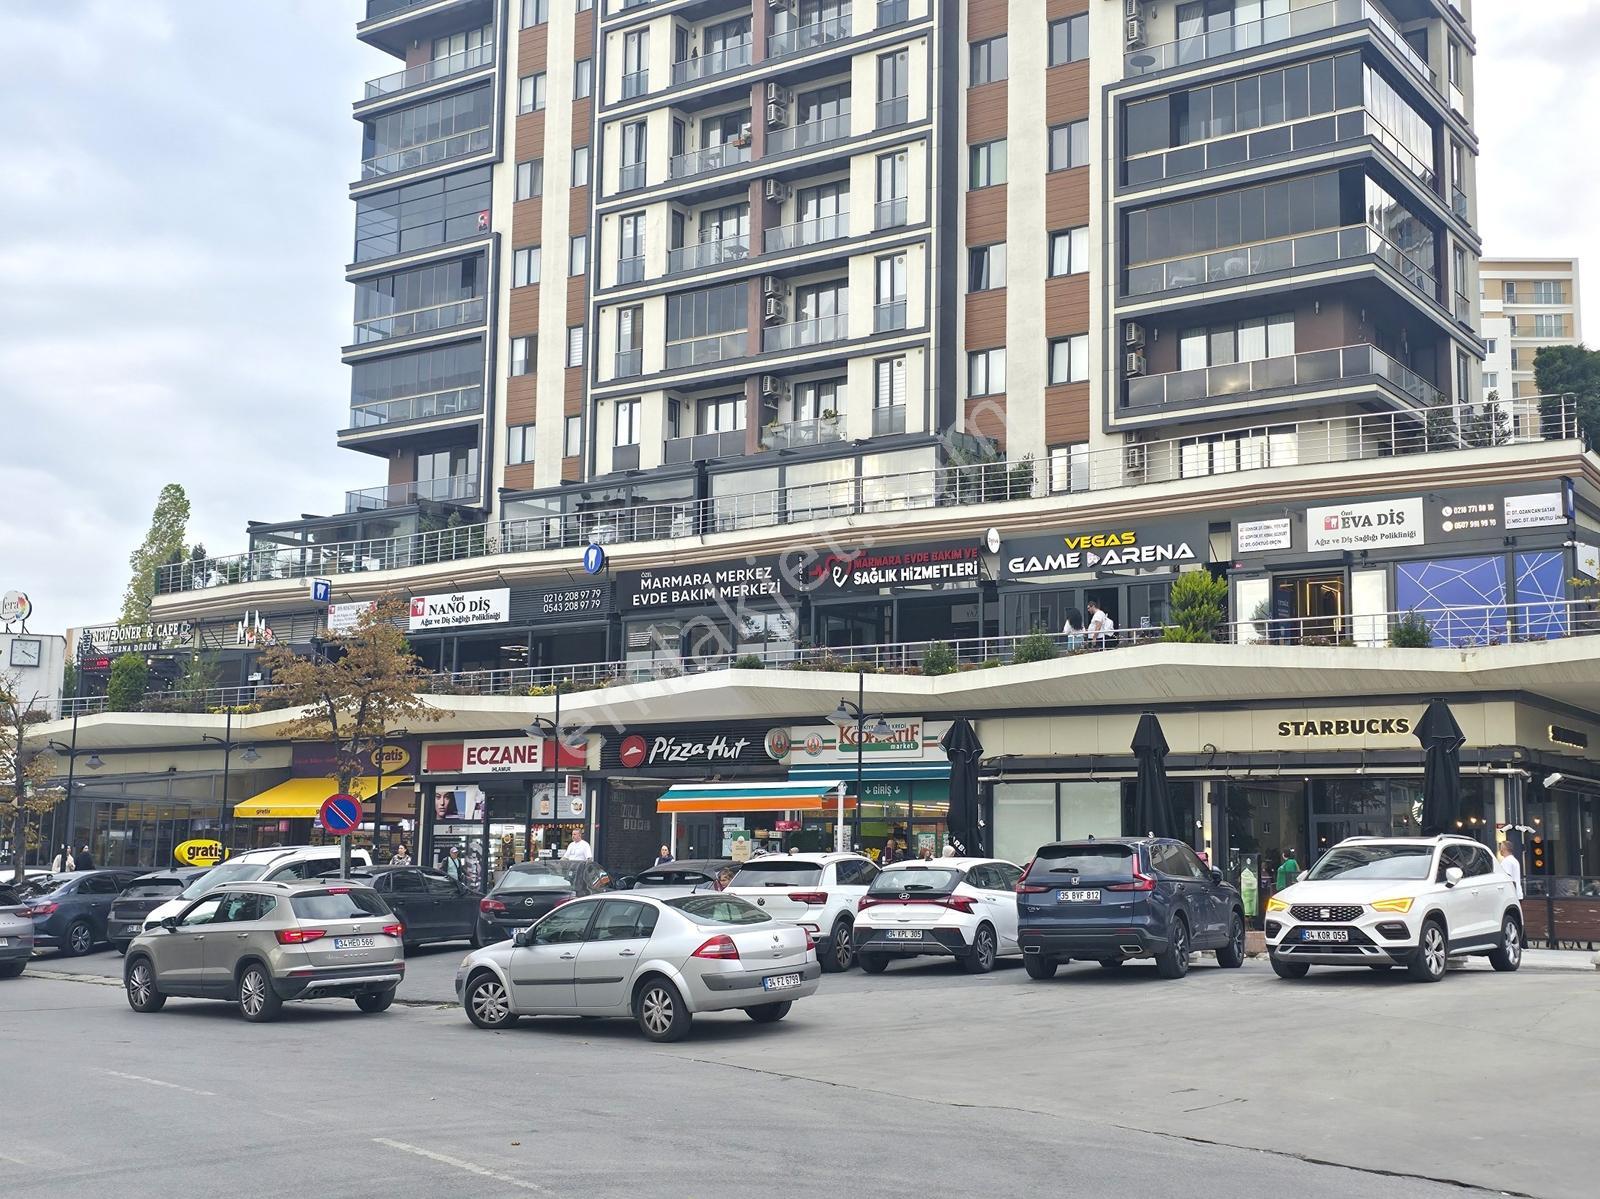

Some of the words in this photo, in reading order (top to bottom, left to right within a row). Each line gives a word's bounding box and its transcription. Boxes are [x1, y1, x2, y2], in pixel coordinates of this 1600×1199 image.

[1341, 515, 1373, 529] EVA
[1377, 508, 1405, 525] DİŞ
[1064, 531, 1136, 550] VEGAS
[1314, 538, 1330, 546] Ağız
[1341, 536, 1352, 544] Diş
[1354, 534, 1378, 542] Sağlığı
[1380, 530, 1416, 540] Polikliniği
[854, 555, 901, 569] MARMARA
[904, 552, 928, 563] EVDE
[932, 550, 962, 562] BAKIM
[964, 547, 978, 559] VE
[1008, 552, 1081, 574] GAME
[1100, 542, 1196, 566] ARENA
[640, 573, 712, 590] MARMARA
[716, 566, 772, 584] MERKEZ
[853, 567, 898, 586] SAĞLIK
[543, 593, 562, 603] 0216
[564, 592, 578, 601] 208
[579, 590, 590, 600] 97
[591, 589, 601, 598] 79
[632, 591, 668, 606] EVDE
[671, 587, 716, 603] BAKIM
[720, 578, 781, 598] MERKEZİ
[428, 601, 465, 616] NANO
[469, 596, 490, 613] DİŞ
[543, 603, 563, 613] 0543
[564, 602, 578, 611] 208
[579, 601, 590, 610] 97
[591, 600, 601, 608] 79
[420, 617, 433, 626] Ağız
[441, 616, 450, 624] Diş
[451, 614, 470, 625] Sağlığı
[471, 612, 501, 622] Polikliniği
[146, 623, 153, 638] &
[157, 623, 179, 637] CAFE
[134, 642, 158, 652] DÜRÜM
[1278, 718, 1410, 737] STARBUCKS
[375, 747, 403, 763] gratis
[466, 745, 538, 765] ECZANE
[649, 736, 705, 764] Pizza
[706, 735, 751, 761] Hut
[872, 784, 892, 797] GİRİŞ
[1061, 892, 1069, 900] 35
[361, 938, 374, 946] 566
[1306, 931, 1314, 940] 34
[1333, 931, 1346, 939] 055
[768, 977, 776, 987] 34
[777, 977, 784, 986] FZ
[785, 974, 799, 985] 6799
